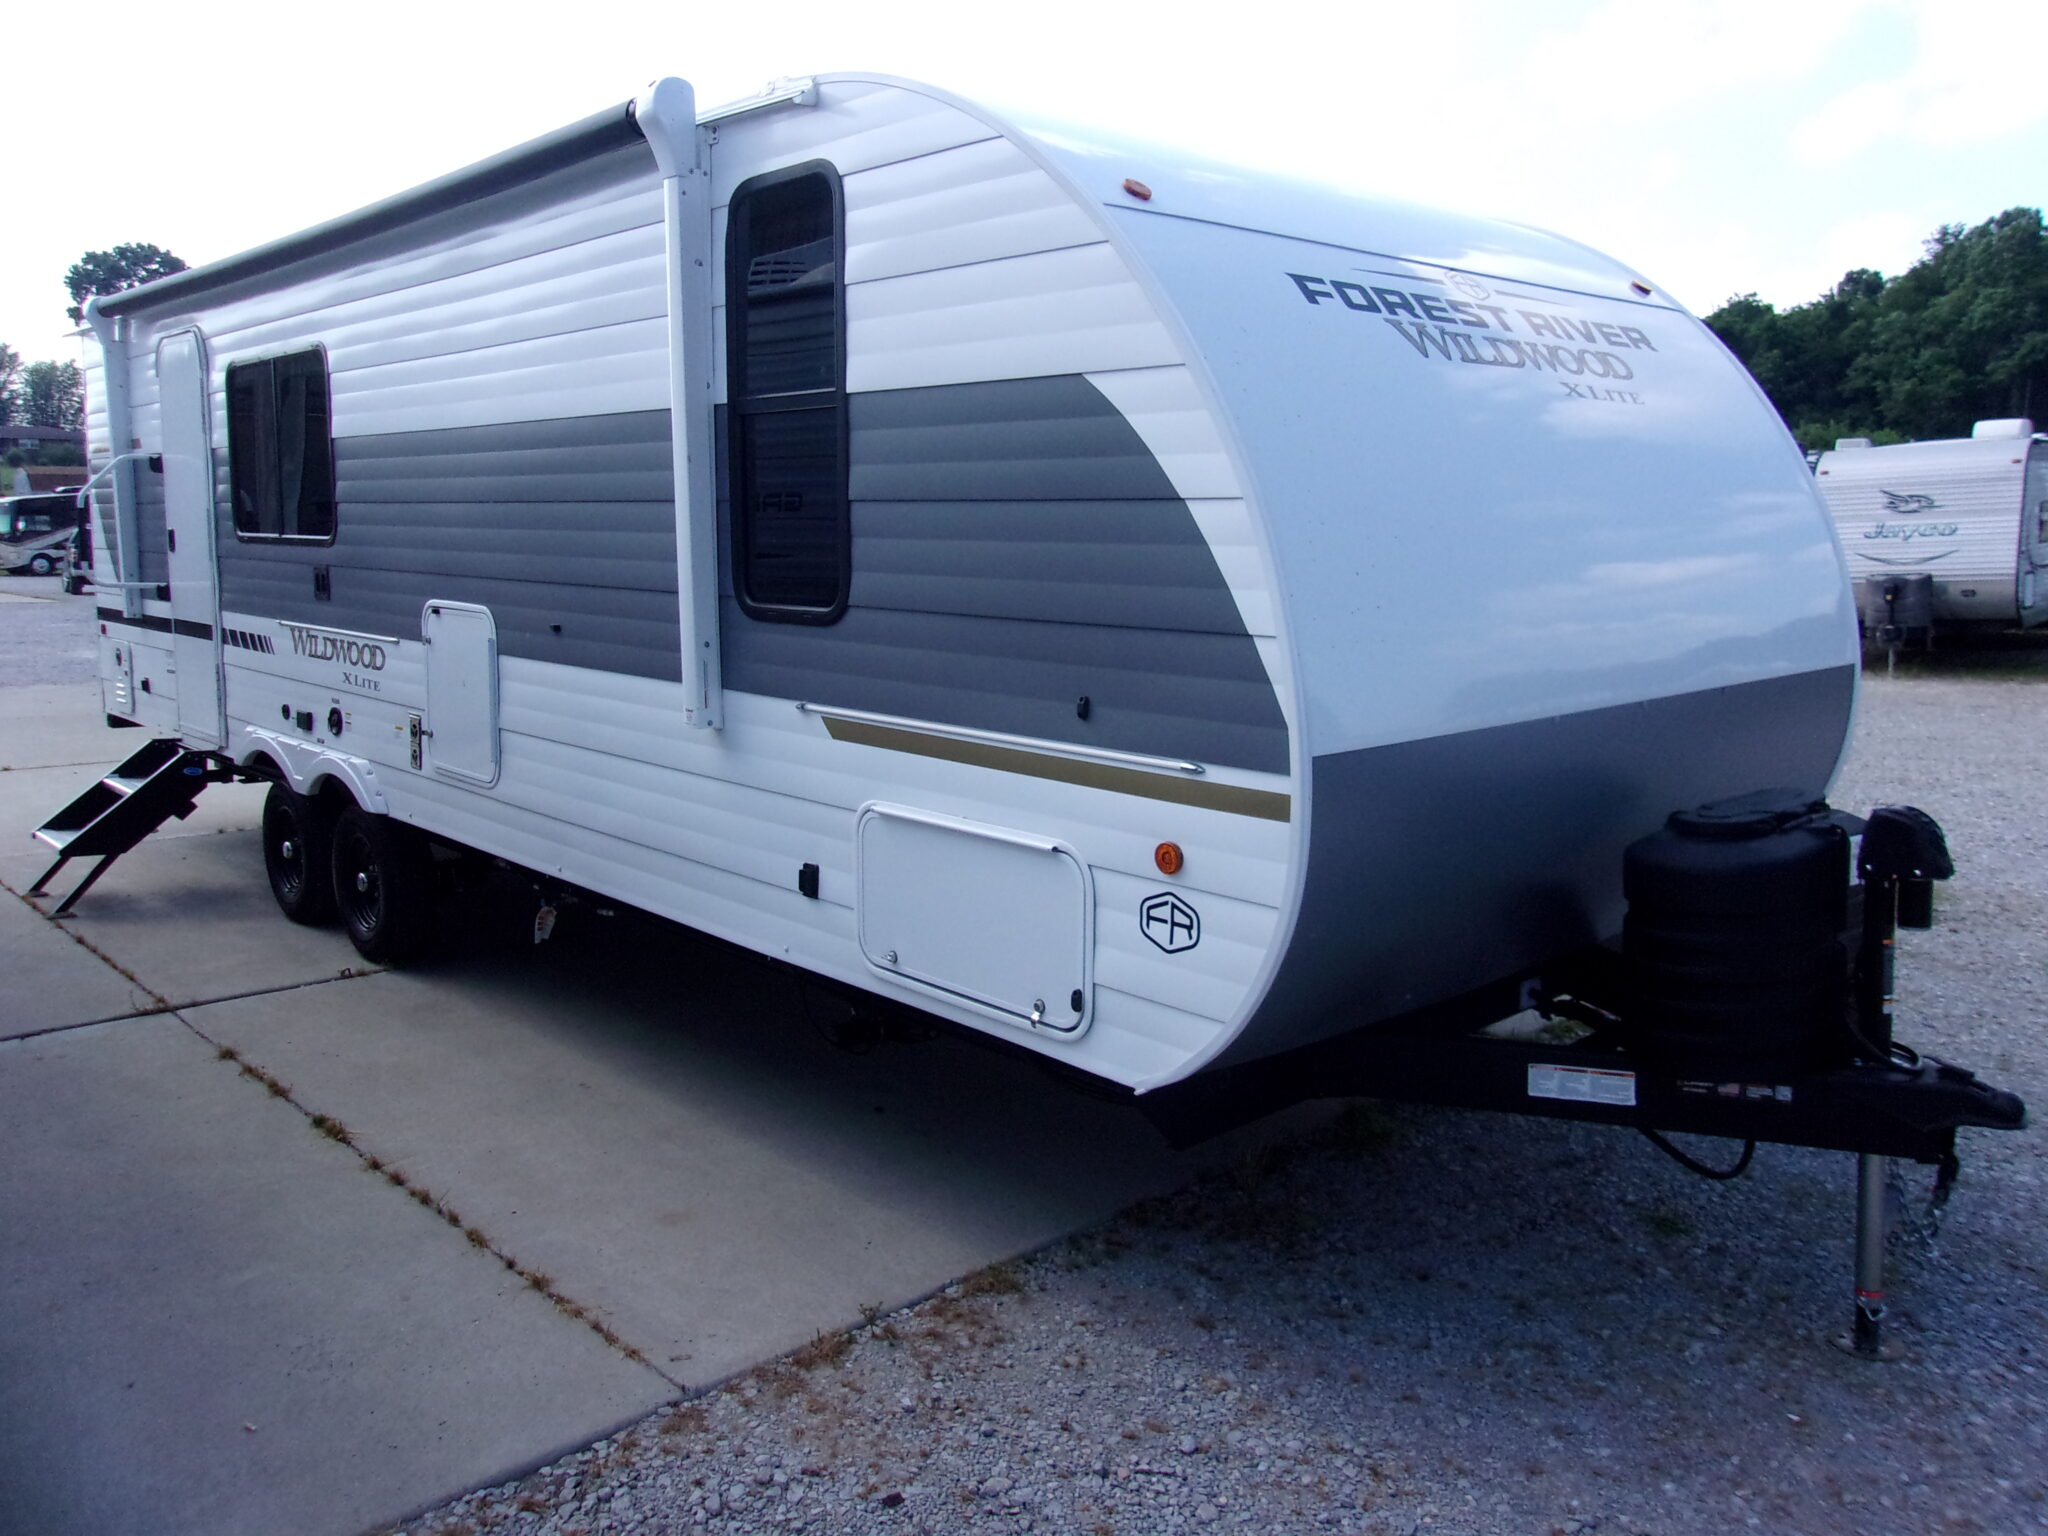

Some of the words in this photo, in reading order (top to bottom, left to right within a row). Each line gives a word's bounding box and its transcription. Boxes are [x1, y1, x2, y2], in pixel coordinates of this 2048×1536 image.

[1285, 272, 1512, 333] FOREST
[1517, 309, 1657, 351] RIVER
[1384, 317, 1634, 380] WILDWOOD
[1559, 381, 1586, 399] X
[1586, 385, 1645, 405] LITE
[1864, 522, 1959, 541] Jayco
[290, 628, 386, 670] WILDWOOD
[343, 672, 353, 685] X
[354, 675, 381, 692] LITE
